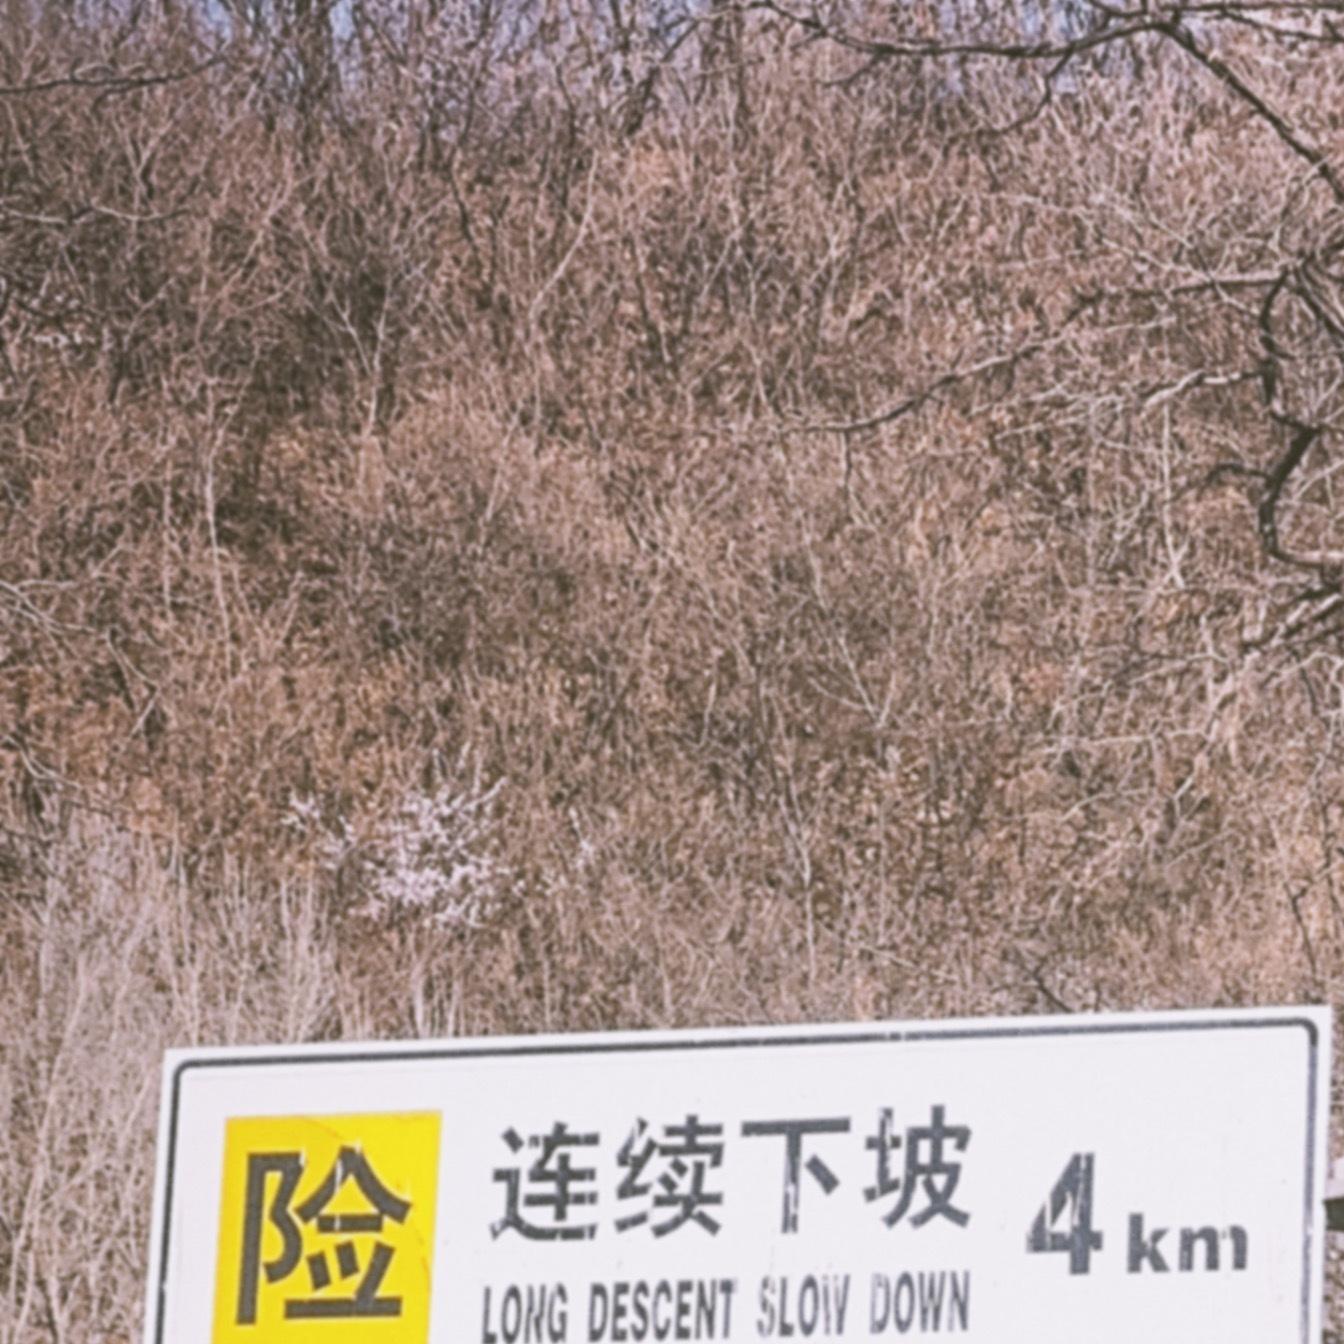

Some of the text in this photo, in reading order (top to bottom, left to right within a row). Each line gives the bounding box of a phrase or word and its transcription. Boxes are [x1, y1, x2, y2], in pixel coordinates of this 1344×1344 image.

[238, 1146, 411, 1325] 险
[490, 1105, 972, 1242] 连续下坡
[1028, 1153, 1249, 1276] 4 km
[587, 1278, 735, 1344] DESCENT
[869, 1270, 970, 1335] DOWN
